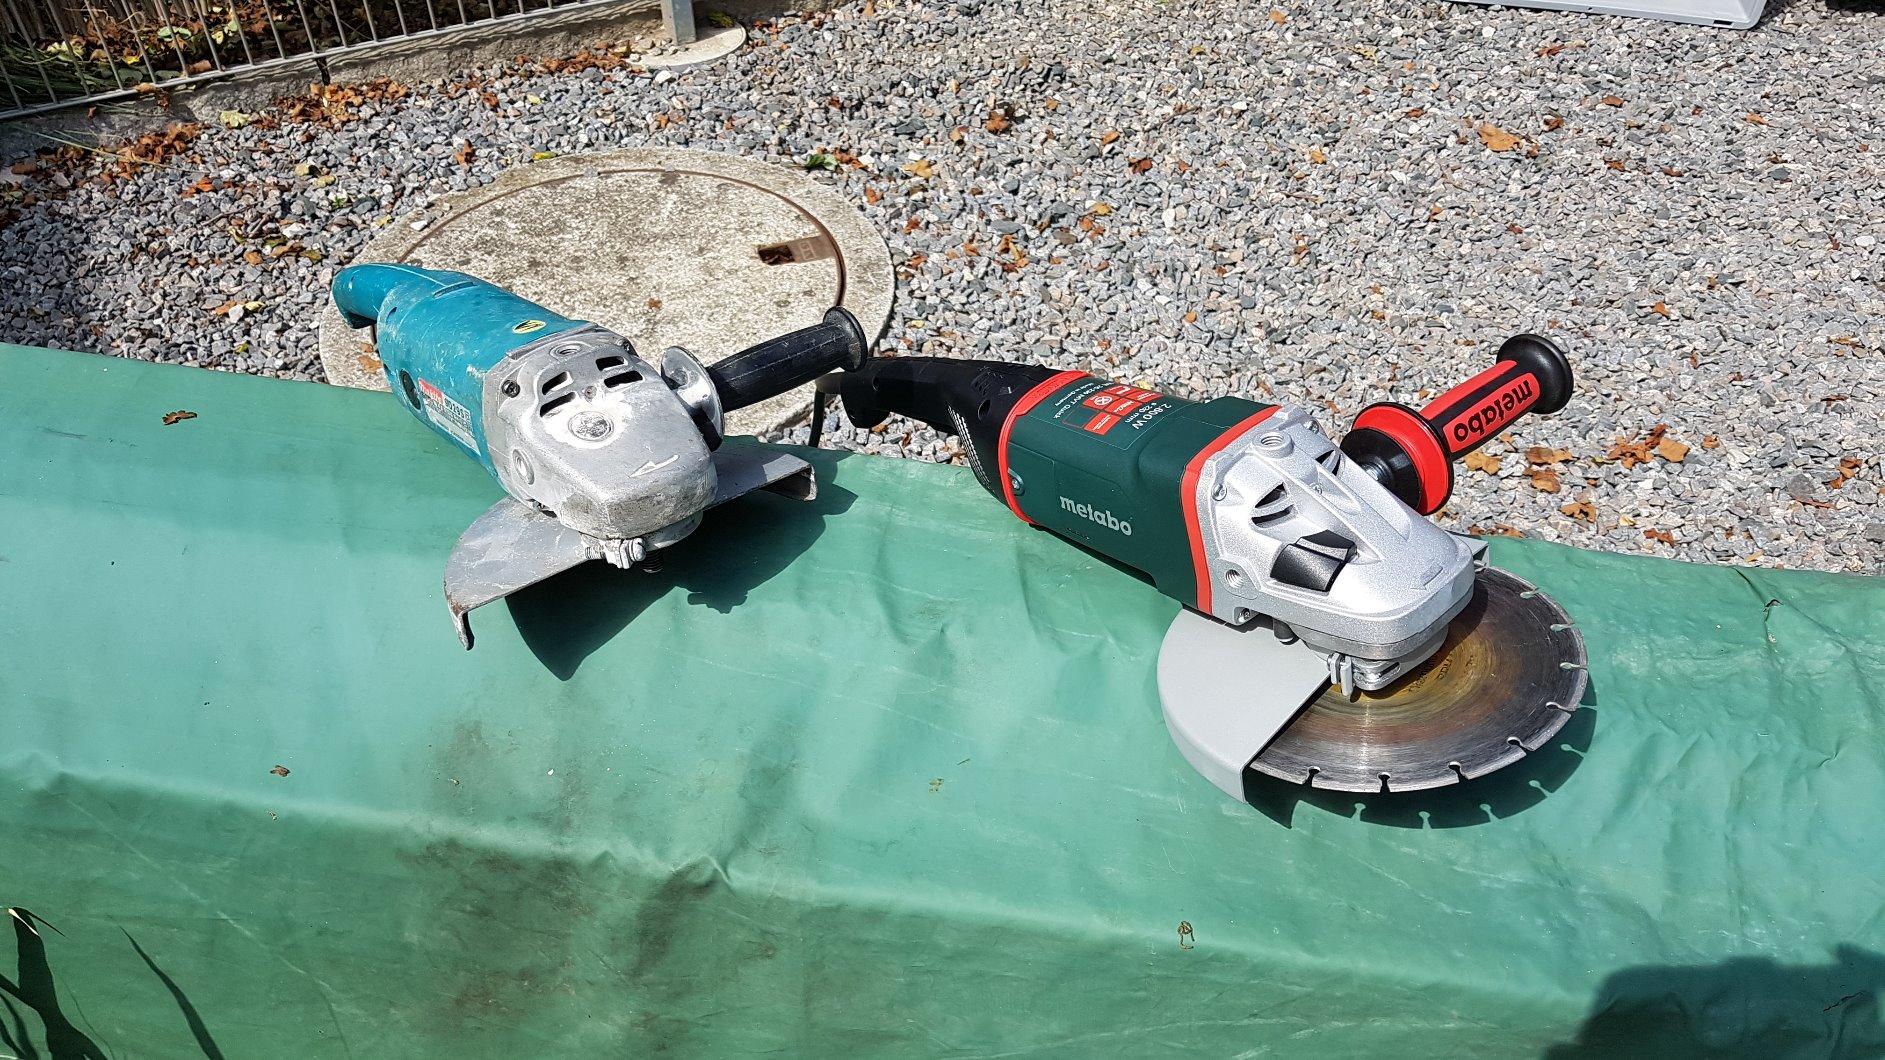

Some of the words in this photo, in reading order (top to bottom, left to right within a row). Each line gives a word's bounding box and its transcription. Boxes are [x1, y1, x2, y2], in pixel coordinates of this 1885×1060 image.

[1132, 419, 1147, 430] W
[1453, 379, 1533, 442] metabo
[1059, 495, 1132, 536] metabo
